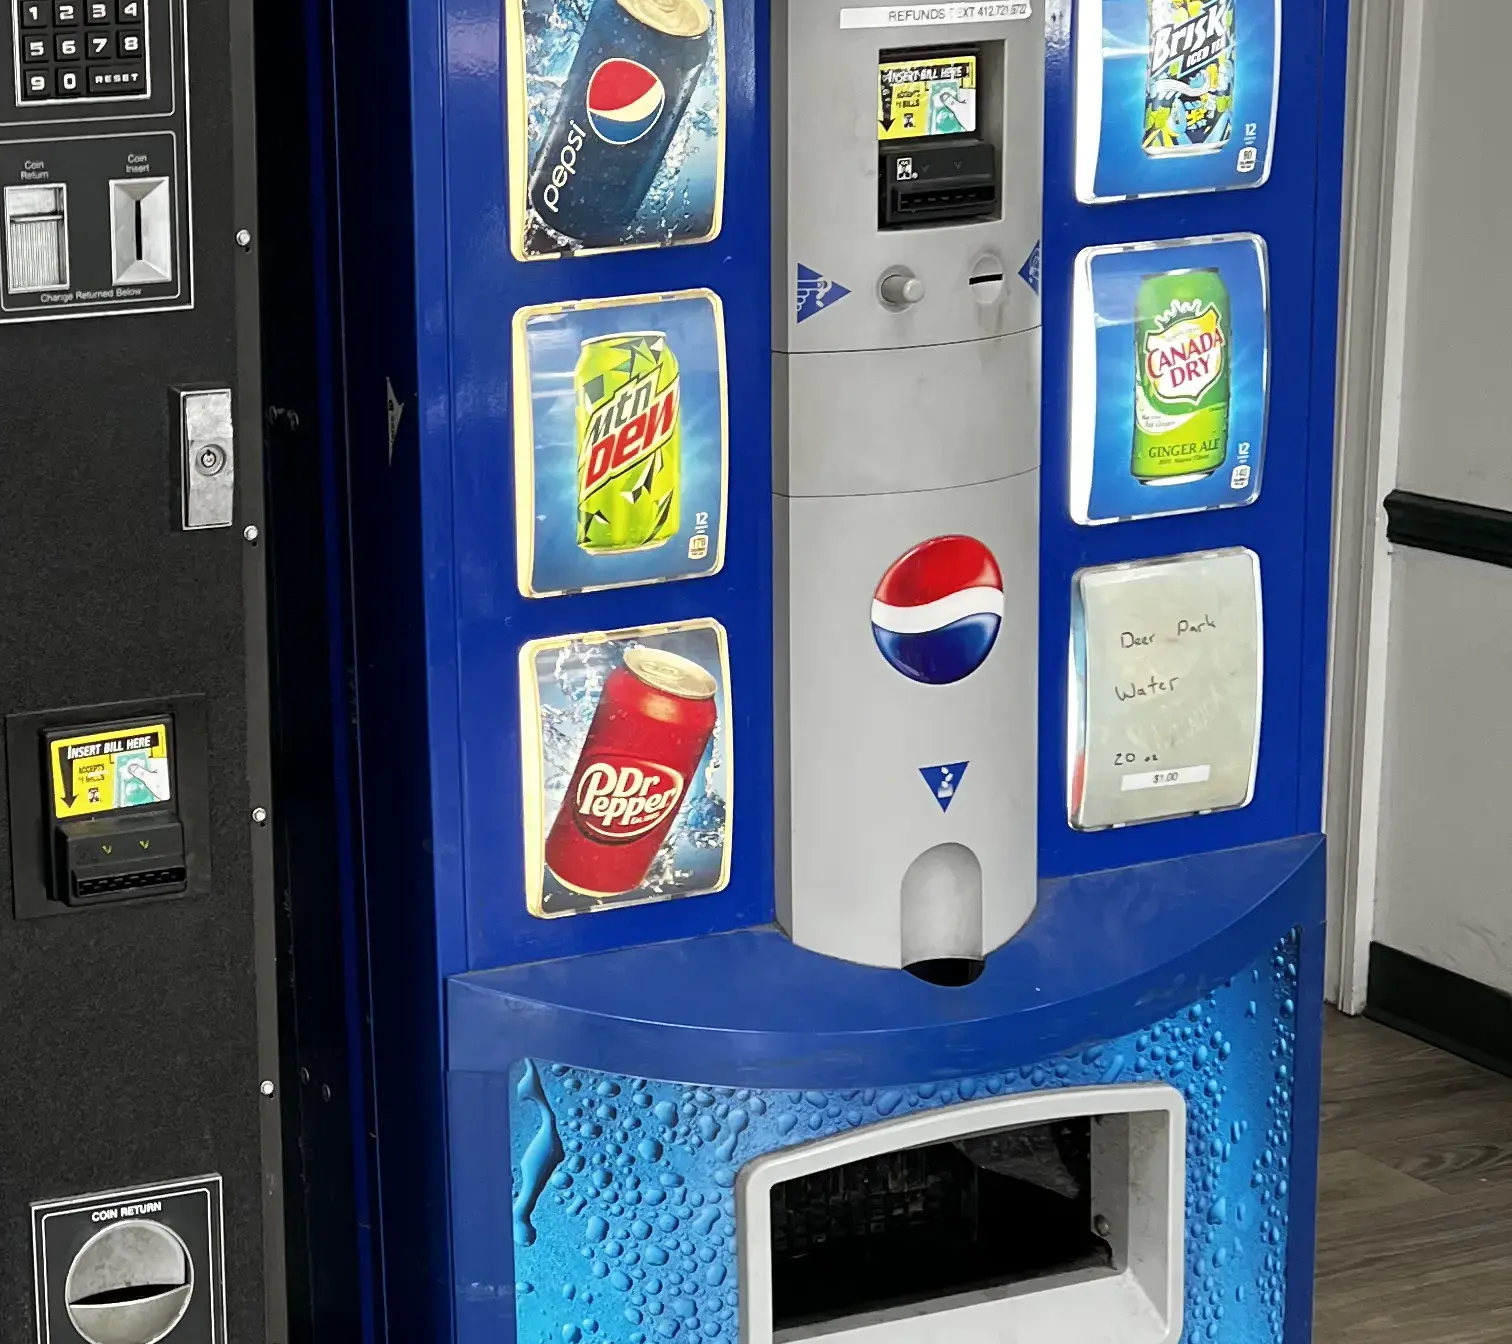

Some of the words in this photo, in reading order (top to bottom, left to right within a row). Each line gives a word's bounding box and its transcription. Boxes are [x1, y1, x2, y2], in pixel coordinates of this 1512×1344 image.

[29, 6, 38, 20] 1
[59, 5, 75, 20] 2
[92, 4, 106, 19] 3
[124, 2, 137, 17] 4
[888, 8, 946, 23] REFUNDS
[30, 41, 44, 56] 5
[62, 39, 76, 54] 6
[93, 38, 108, 53] 7
[124, 36, 138, 51] 8
[31, 76, 45, 91] 9
[63, 72, 76, 89] 0
[95, 72, 139, 84] RESET
[1244, 123, 1257, 137] 12
[24, 160, 45, 171] Coin
[127, 153, 148, 164] Coin
[543, 119, 587, 213] pepsi
[21, 169, 49, 180] Return
[41, 291, 74, 304] Change
[75, 288, 114, 300] Returned
[116, 286, 142, 297] Below
[1148, 327, 1224, 379] CANADA
[1170, 353, 1213, 389] DRY
[1148, 441, 1198, 459] GINGER
[1199, 437, 1222, 453] ALE
[1238, 441, 1250, 455] 12
[695, 511, 709, 526] 12
[1120, 631, 1157, 649] Deer
[1176, 613, 1216, 637] Park
[1114, 675, 1180, 703] Water
[67, 742, 101, 761] INSERT
[104, 739, 124, 754] BILL
[126, 735, 152, 751] HERE
[1113, 752, 1136, 766] 20
[613, 766, 662, 798] Dr
[578, 762, 677, 827] Pepper
[91, 1209, 119, 1223] COIN
[120, 1201, 163, 1219] RETURN
